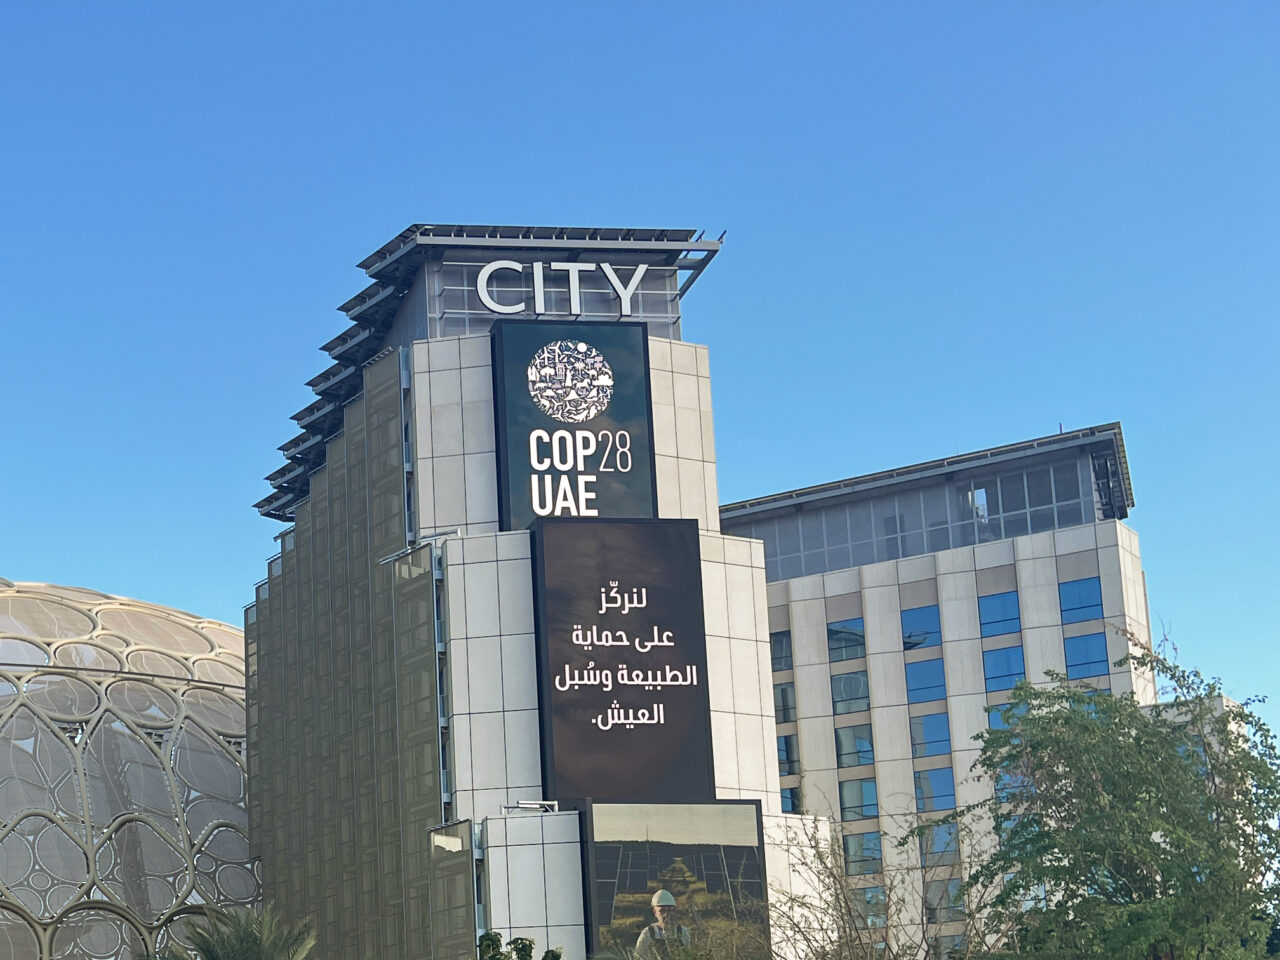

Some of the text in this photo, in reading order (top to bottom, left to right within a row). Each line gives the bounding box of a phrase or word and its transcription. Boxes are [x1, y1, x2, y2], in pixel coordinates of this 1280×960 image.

[476, 260, 649, 316] CITY
[529, 429, 632, 473] COP28
[530, 474, 599, 517] UAE
[571, 624, 675, 653] على حماية
[617, 664, 698, 691] الطبيعة
[590, 699, 665, 731] العيش.
